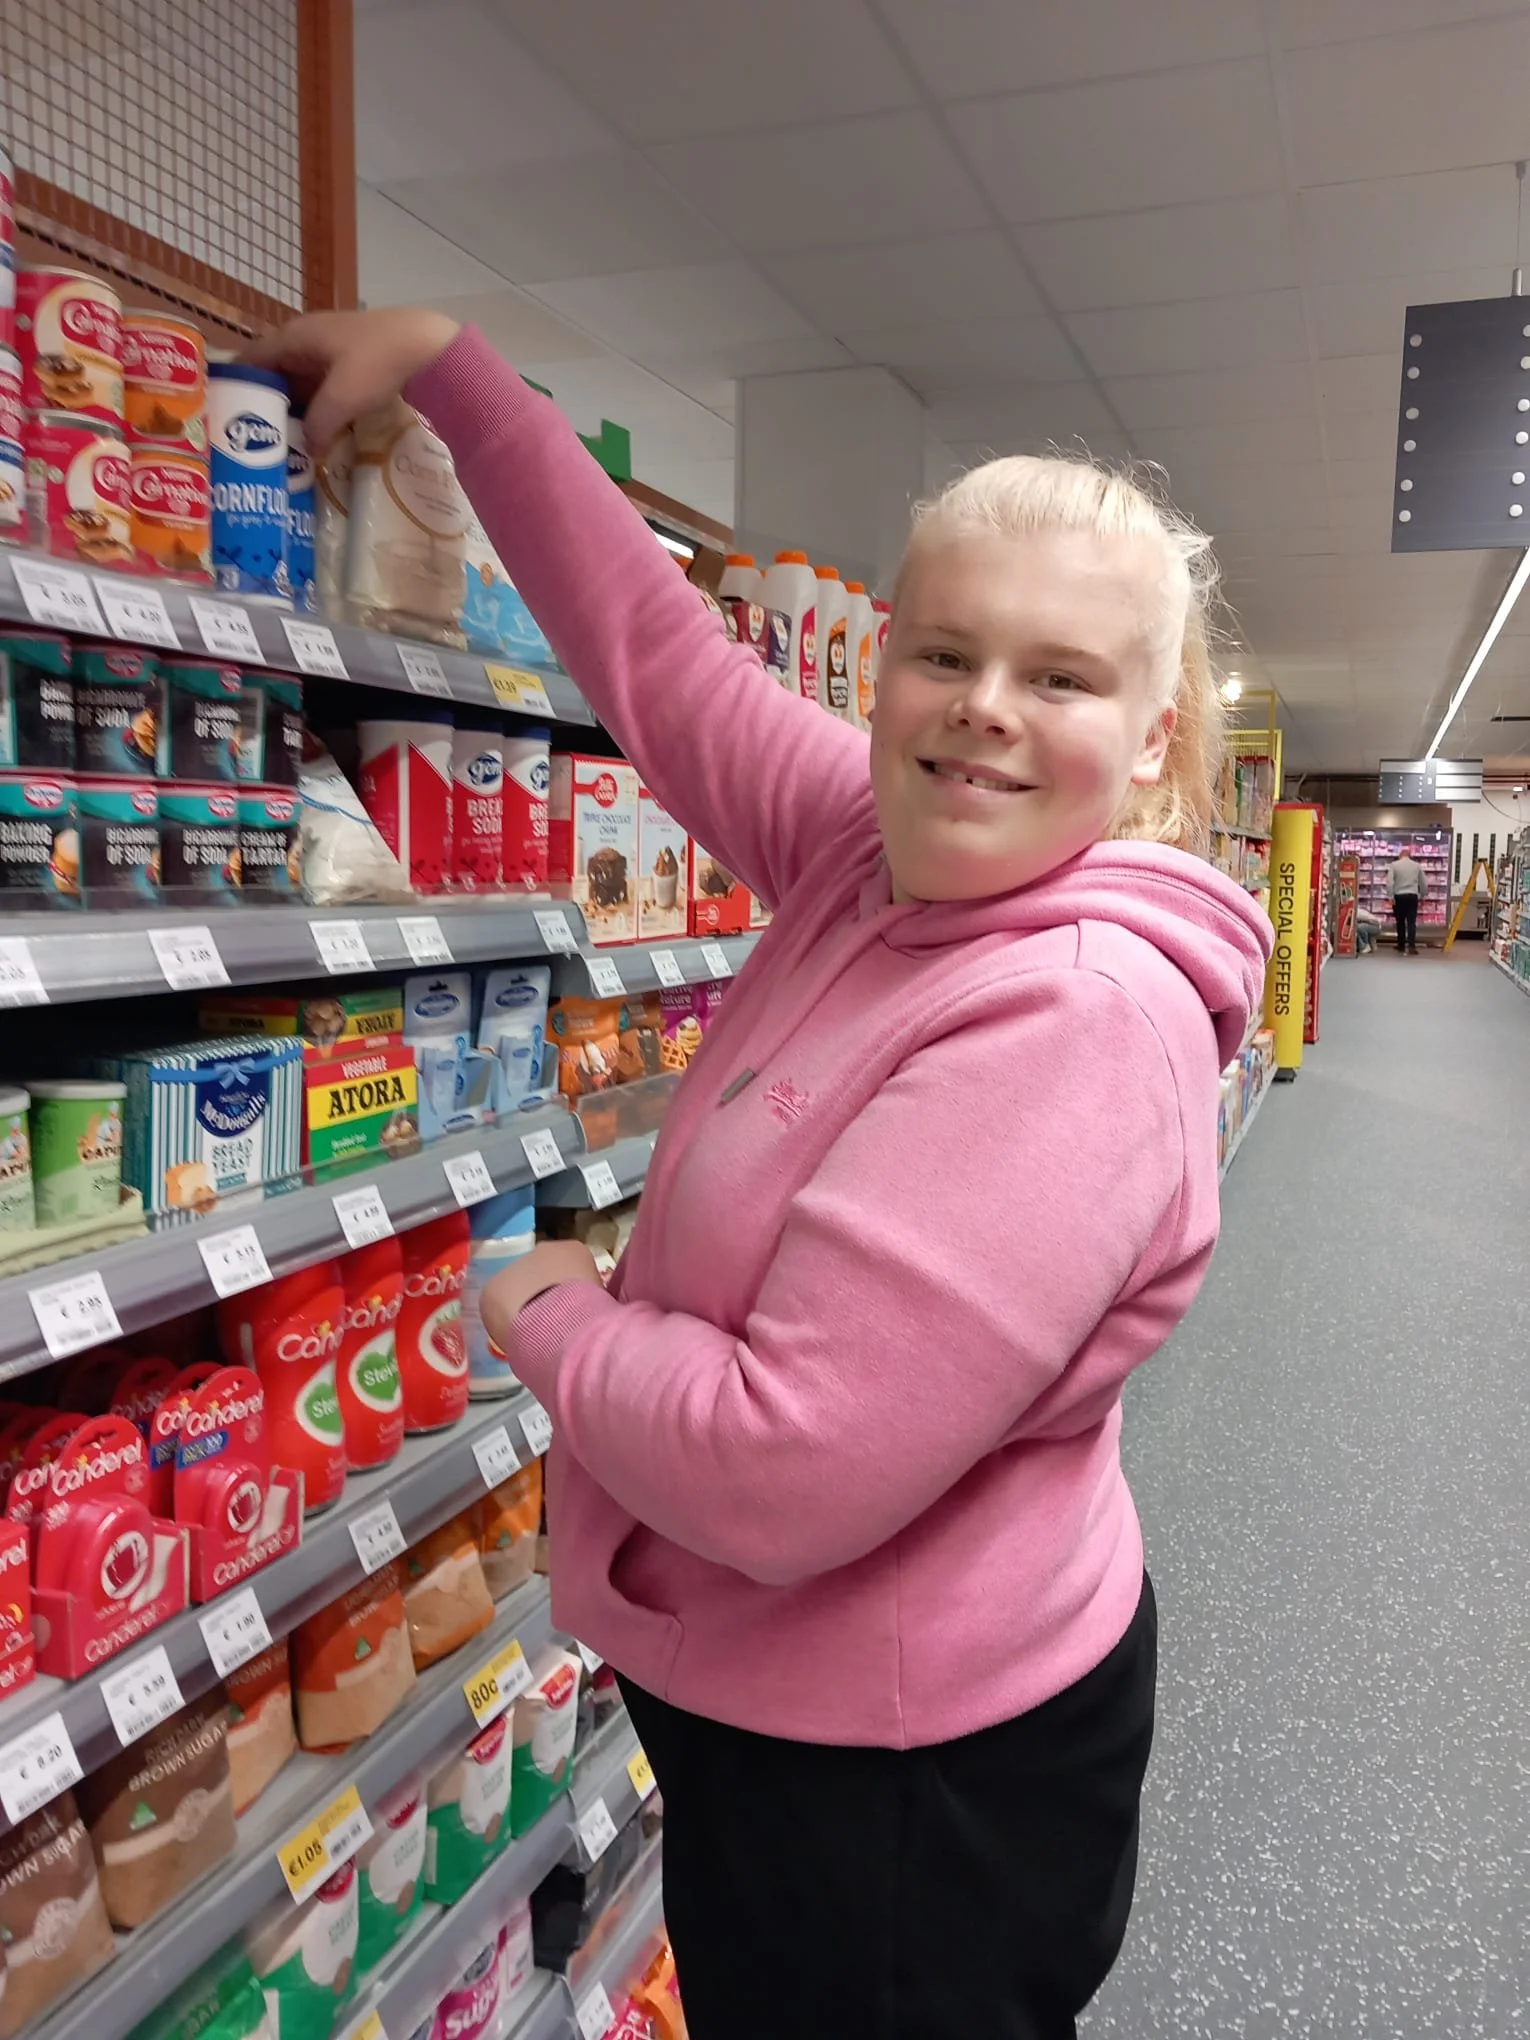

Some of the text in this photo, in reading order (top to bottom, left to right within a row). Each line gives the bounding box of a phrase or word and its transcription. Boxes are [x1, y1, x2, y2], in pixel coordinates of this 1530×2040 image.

[1274, 862, 1295, 1016] SPECIAL OFFERS
[327, 1075, 407, 1119] ATORA
[186, 1389, 265, 1438] Canderel
[52, 1437, 143, 1498] Canderel
